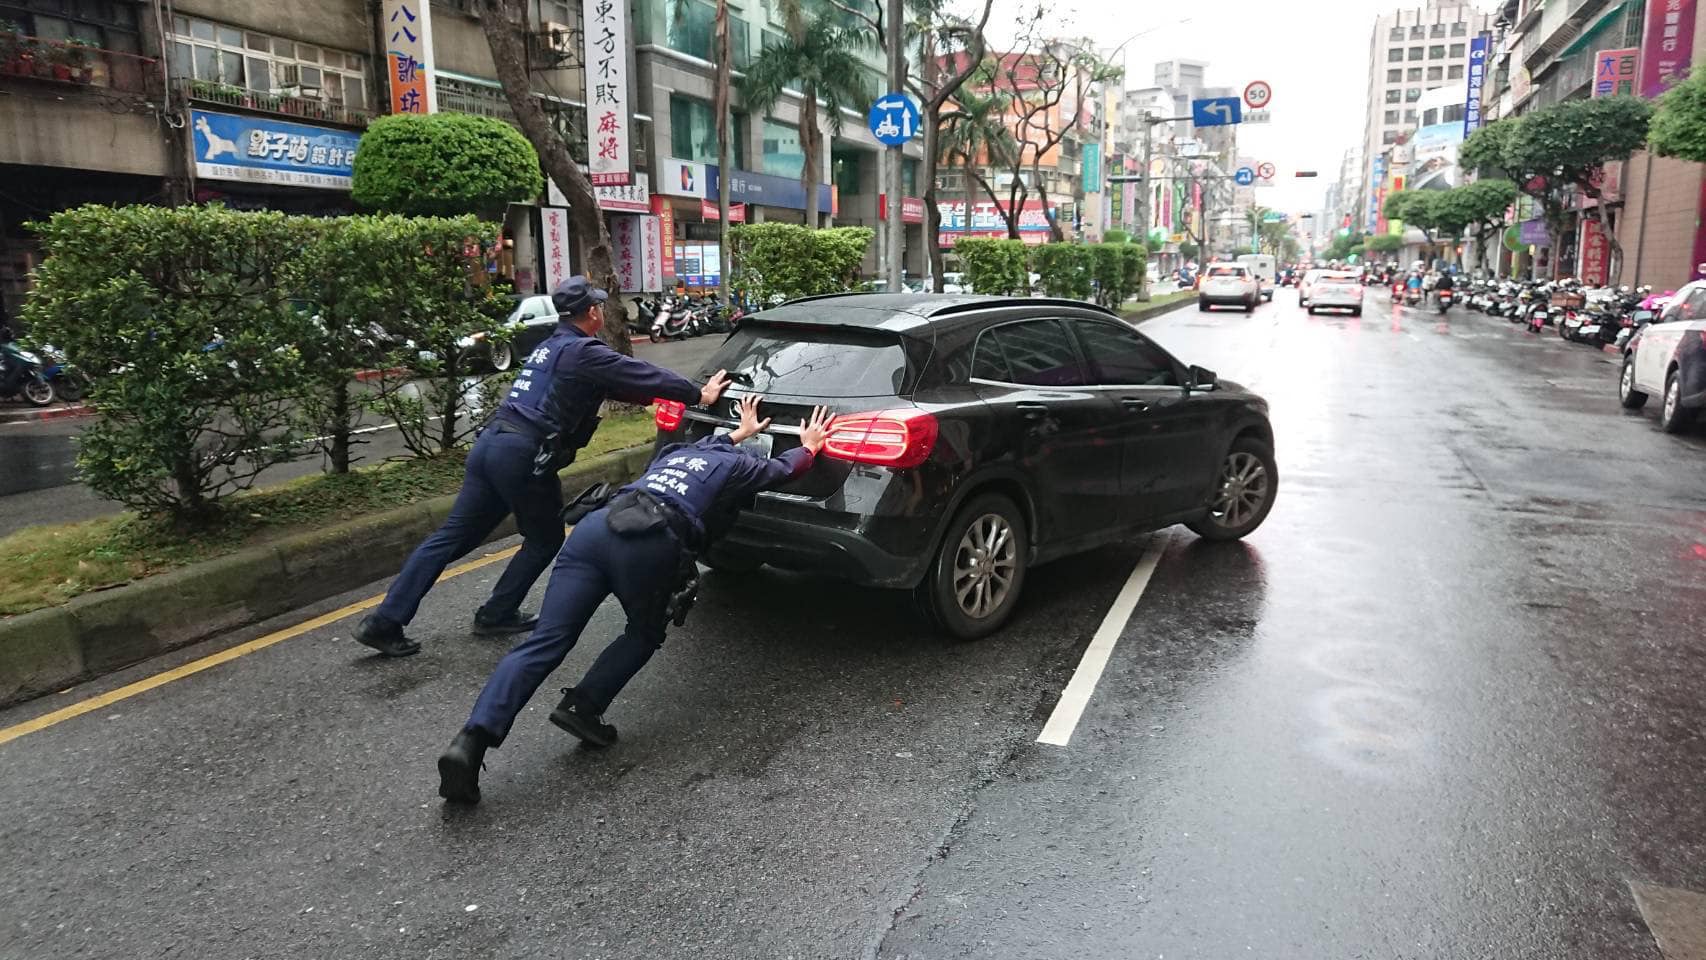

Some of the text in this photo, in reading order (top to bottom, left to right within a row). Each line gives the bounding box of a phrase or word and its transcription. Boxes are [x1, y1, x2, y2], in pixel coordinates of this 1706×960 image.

[391, 4, 420, 113] 八八歌坊
[1249, 89, 1266, 100] 50
[248, 129, 310, 162] 點子站
[716, 175, 746, 194] 銀行
